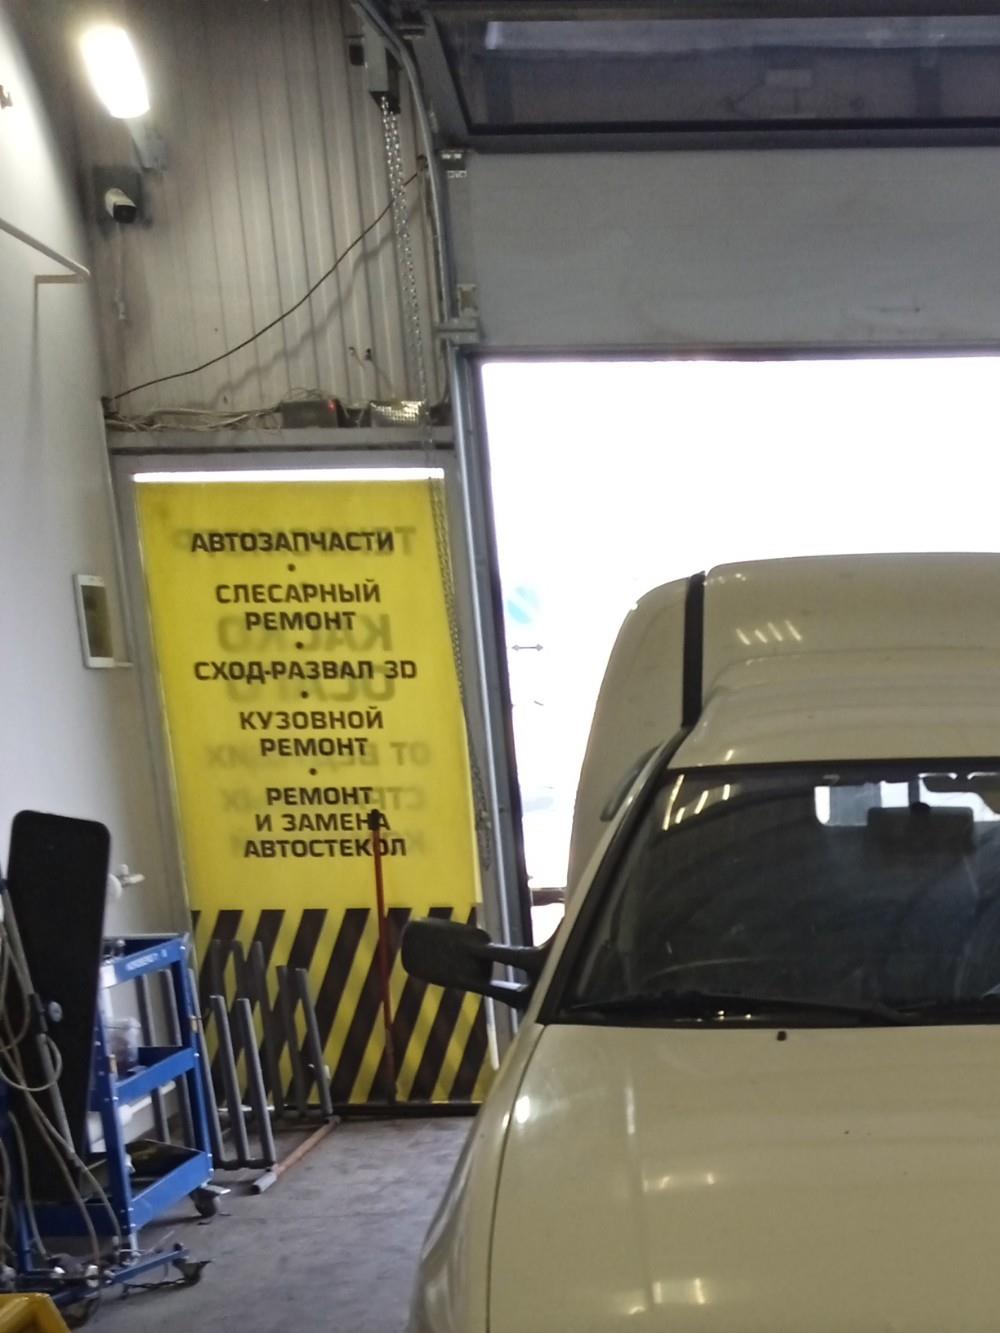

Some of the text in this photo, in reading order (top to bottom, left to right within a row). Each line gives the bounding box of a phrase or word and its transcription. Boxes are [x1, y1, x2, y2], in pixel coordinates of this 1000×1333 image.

[191, 531, 394, 553] АВТОЗАПЧАСТИ
[215, 578, 381, 604] СЛЕСАРНЫЙ
[245, 611, 356, 631] РЕМОНТ
[194, 660, 418, 685] СХОД-РАЗВАЛ 3D
[239, 706, 384, 730] КУЗОВНОЙ
[260, 738, 368, 756] РЕМОНТ
[266, 787, 373, 806] РЕМОНТ
[255, 813, 391, 832] И ЗАМЕНА
[243, 838, 406, 858] АВТОСТЕКОЛ
